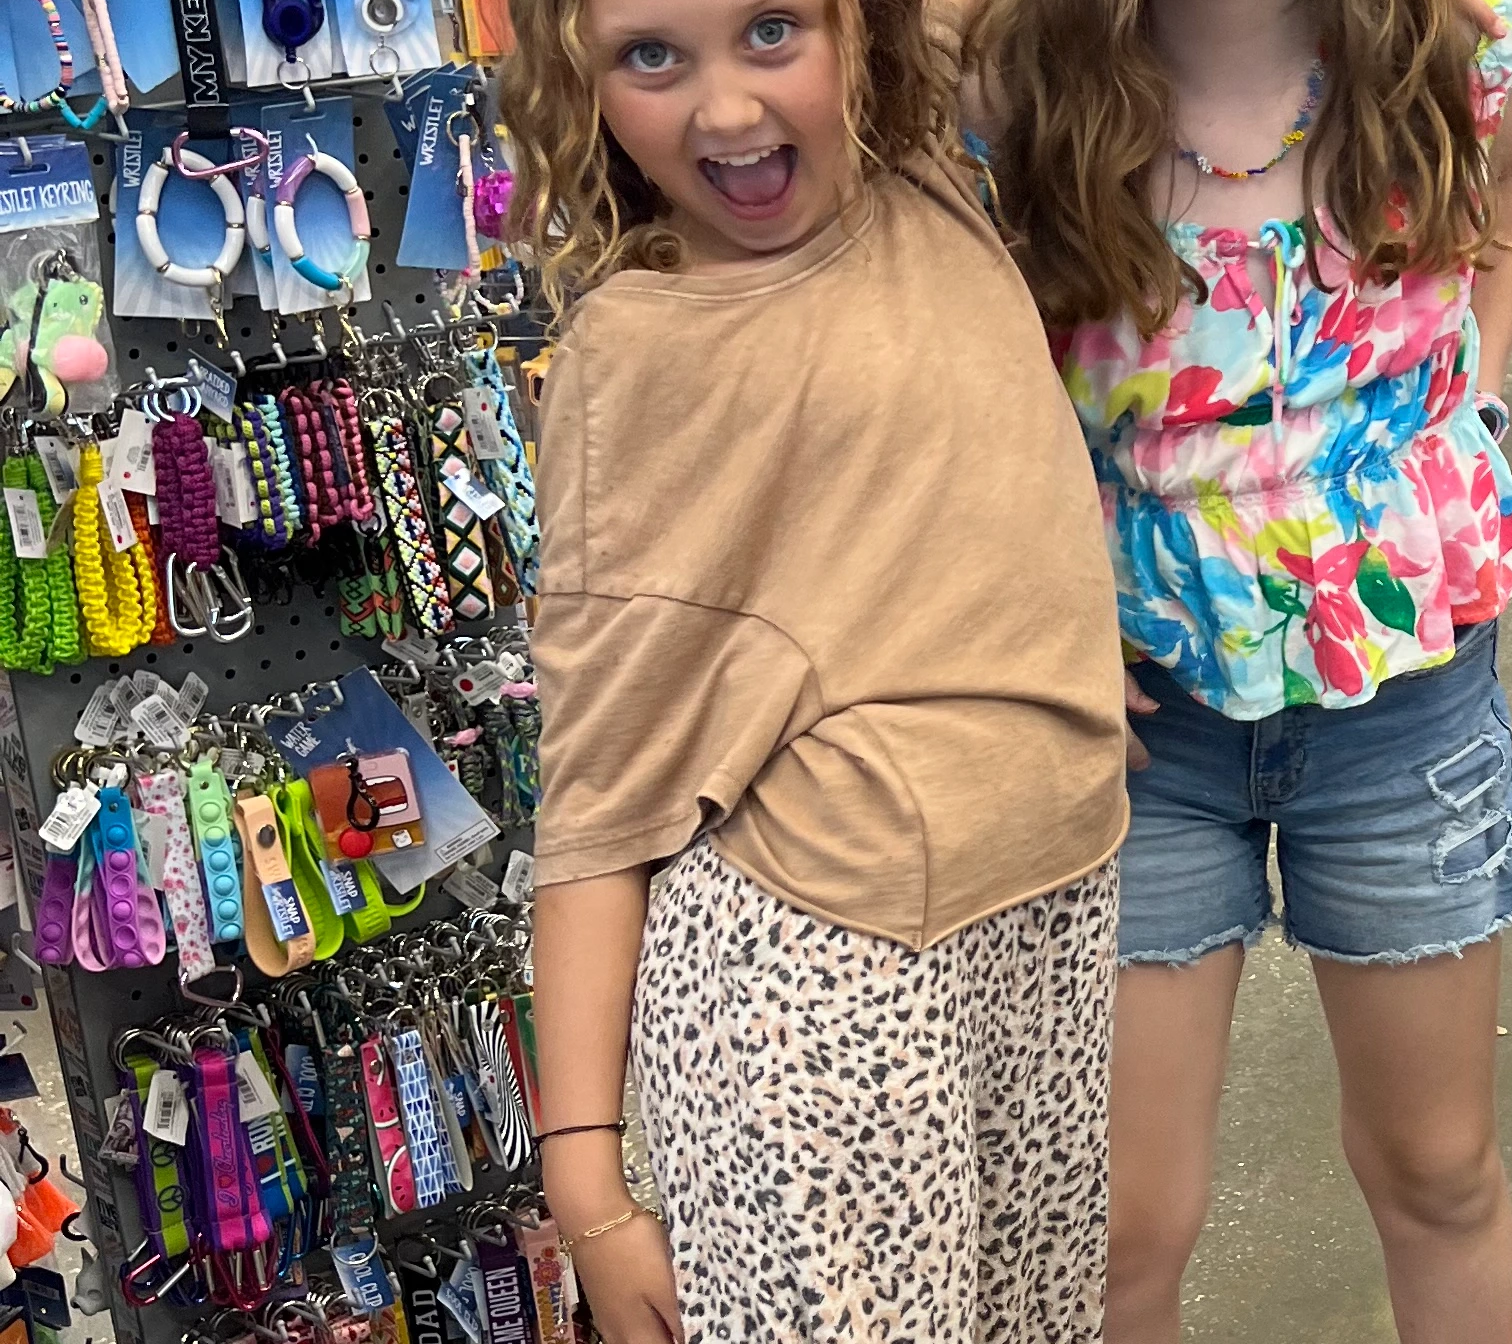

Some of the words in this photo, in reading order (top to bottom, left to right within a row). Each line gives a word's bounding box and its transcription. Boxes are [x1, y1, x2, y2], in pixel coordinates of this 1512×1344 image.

[187, 44, 221, 106] MY
[419, 95, 445, 167] WRISTLET
[38, 181, 95, 211] KEYRING
[279, 720, 313, 752] WATER
[294, 734, 323, 757] GAME
[343, 869, 359, 899] SNAP
[285, 895, 302, 925] SNAP
[484, 1265, 522, 1319] QUEEN
